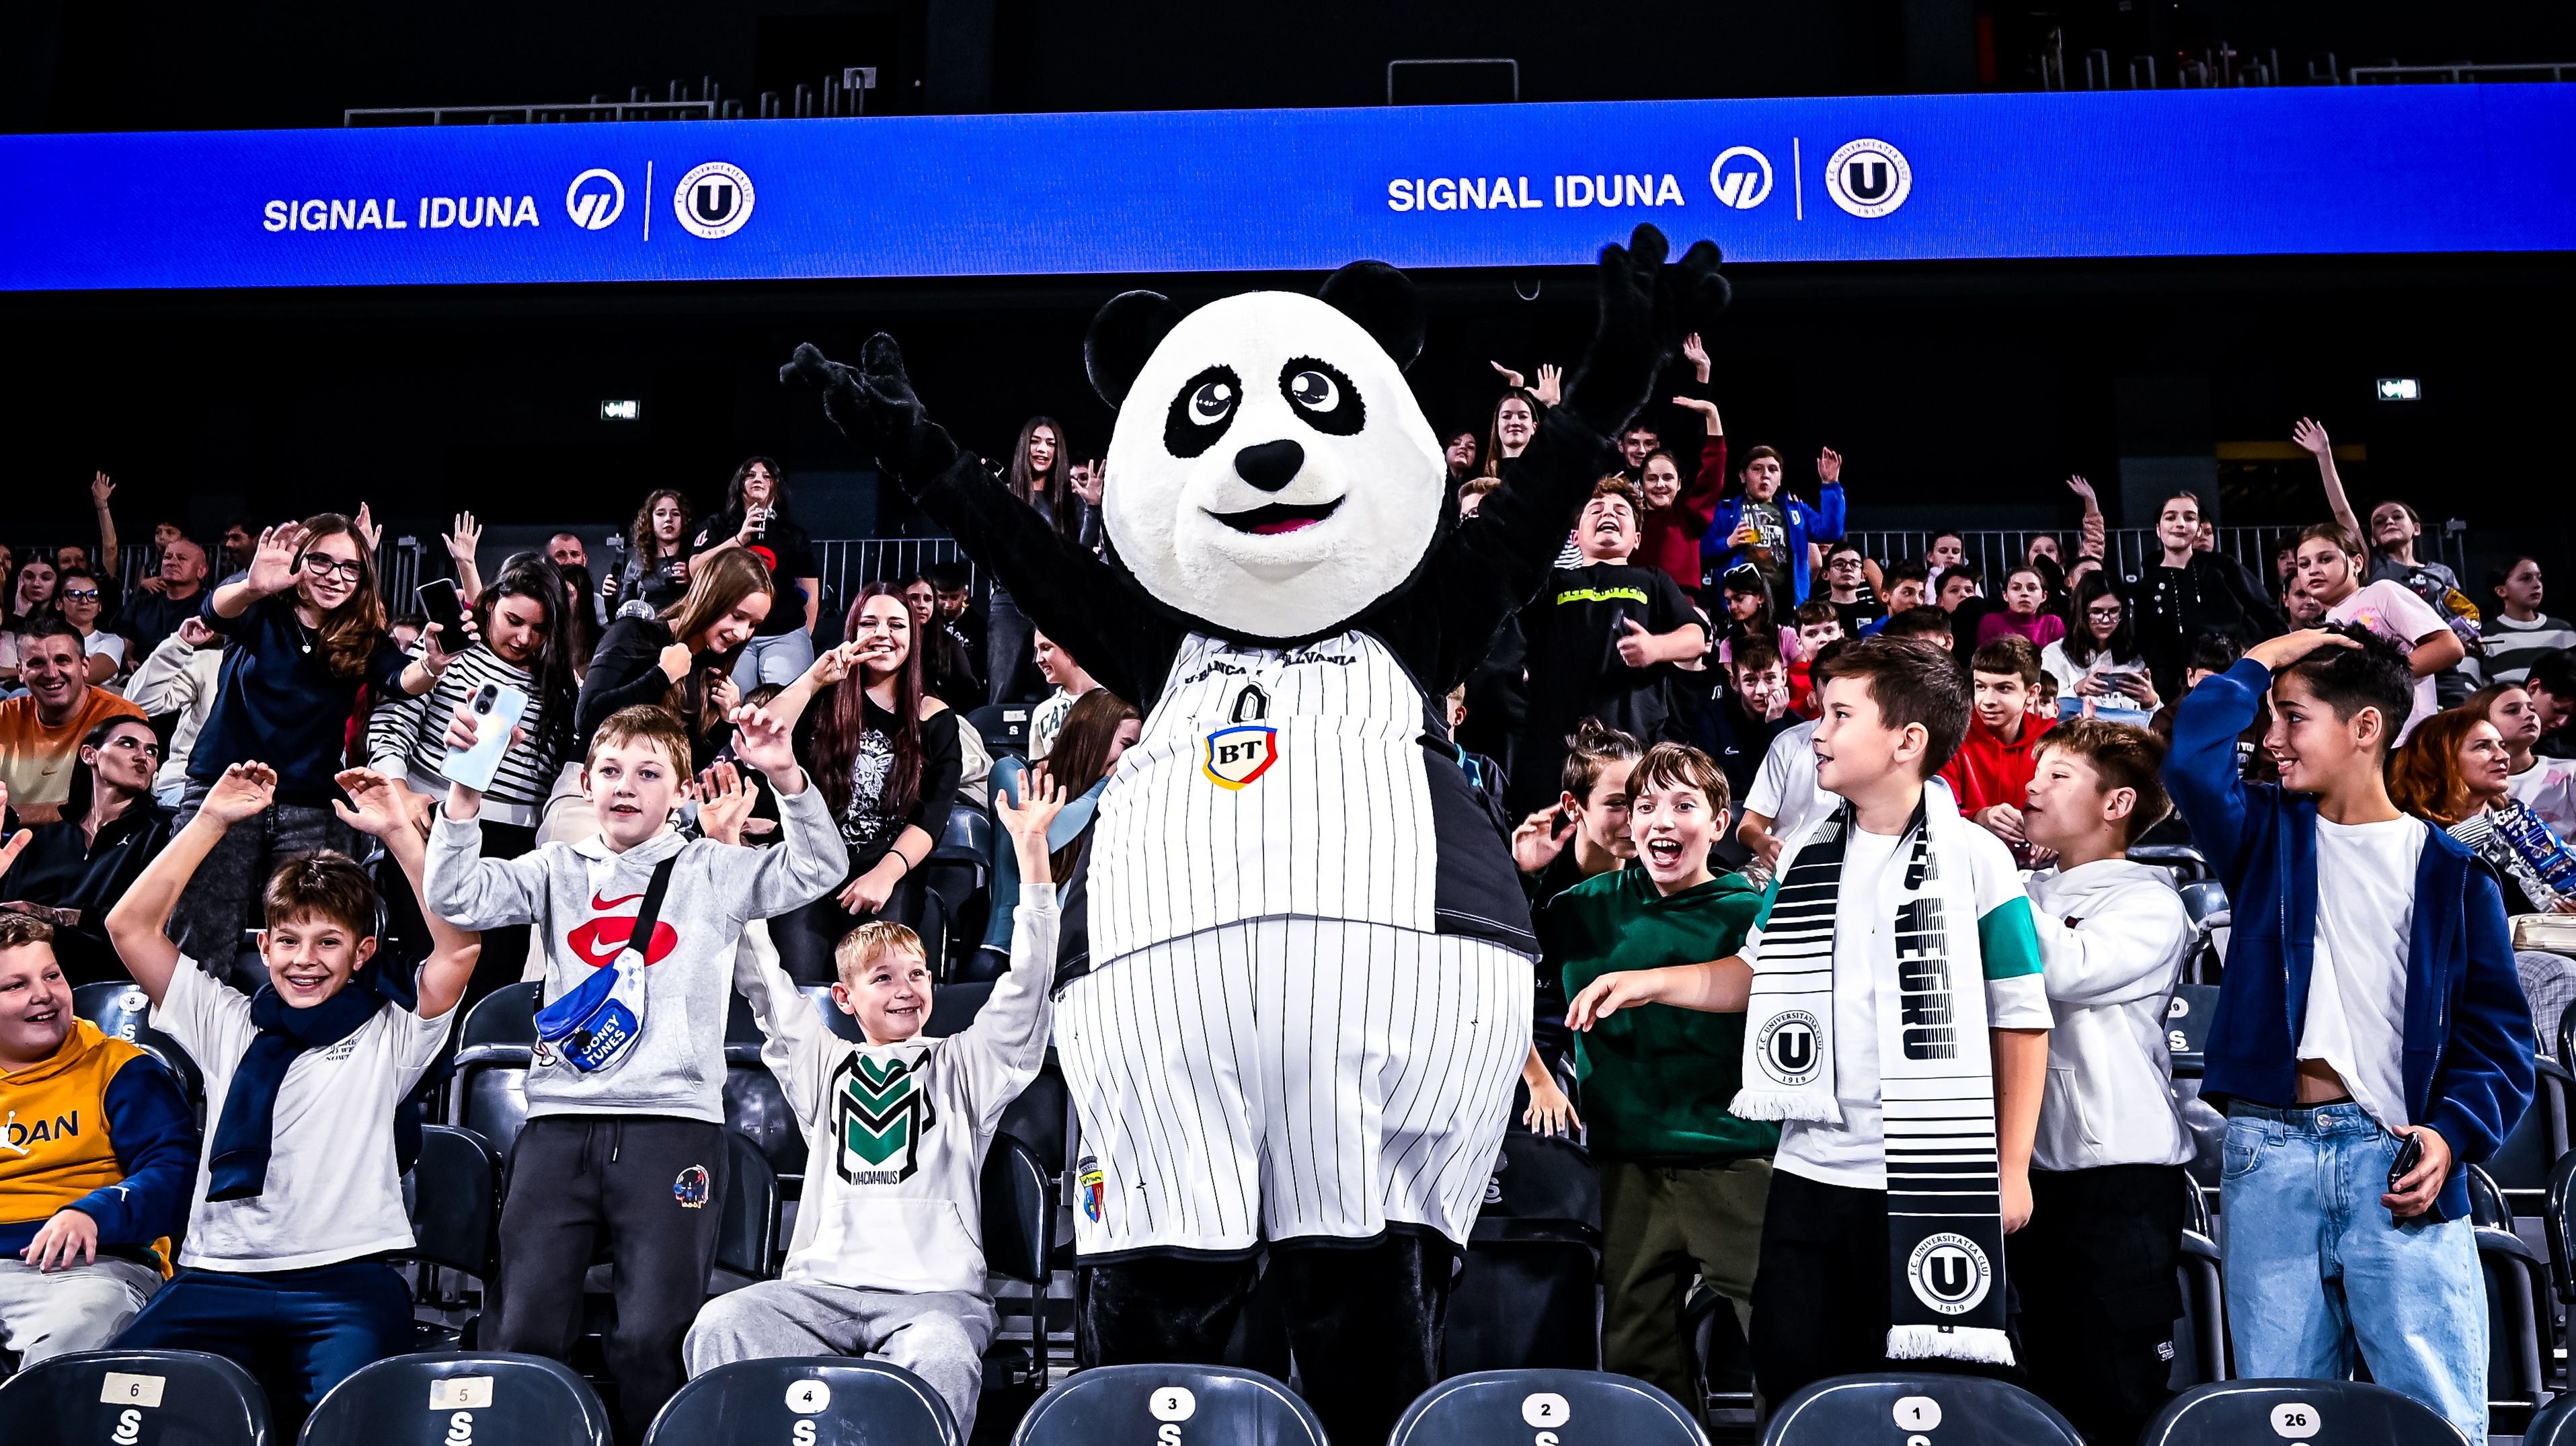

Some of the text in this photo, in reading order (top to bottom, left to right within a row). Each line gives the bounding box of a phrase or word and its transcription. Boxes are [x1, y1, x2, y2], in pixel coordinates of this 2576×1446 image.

[1388, 173, 1685, 212] SIGNAL IDUNA
[1849, 162, 1887, 200] U
[264, 195, 540, 233] SIGNAL IDUNA
[697, 184, 733, 221] U
[1218, 740, 1262, 765] BT
[1894, 897, 1958, 1061] NEGRU
[586, 1029, 626, 1066] TUNES
[1778, 1032, 1811, 1069] U
[2169, 1030, 2187, 1049] S
[1783, 1076, 1806, 1084] 1919
[4, 1109, 79, 1147] DAN
[1914, 1235, 1978, 1258] UNIVERSITATEA
[1978, 1255, 1989, 1277] CLUJ
[1930, 1256, 1969, 1297] U
[1939, 1304, 1965, 1312] 1919
[130, 1383, 140, 1398] 6
[459, 1388, 469, 1402] 5
[803, 1390, 813, 1402] 4
[1168, 1398, 1177, 1410] 3
[116, 1409, 142, 1438] S
[1540, 1403, 1551, 1416] 2
[1912, 1407, 1920, 1420] 1
[2284, 1413, 2307, 1427] 26
[448, 1411, 473, 1441] S
[792, 1419, 817, 1446] S
